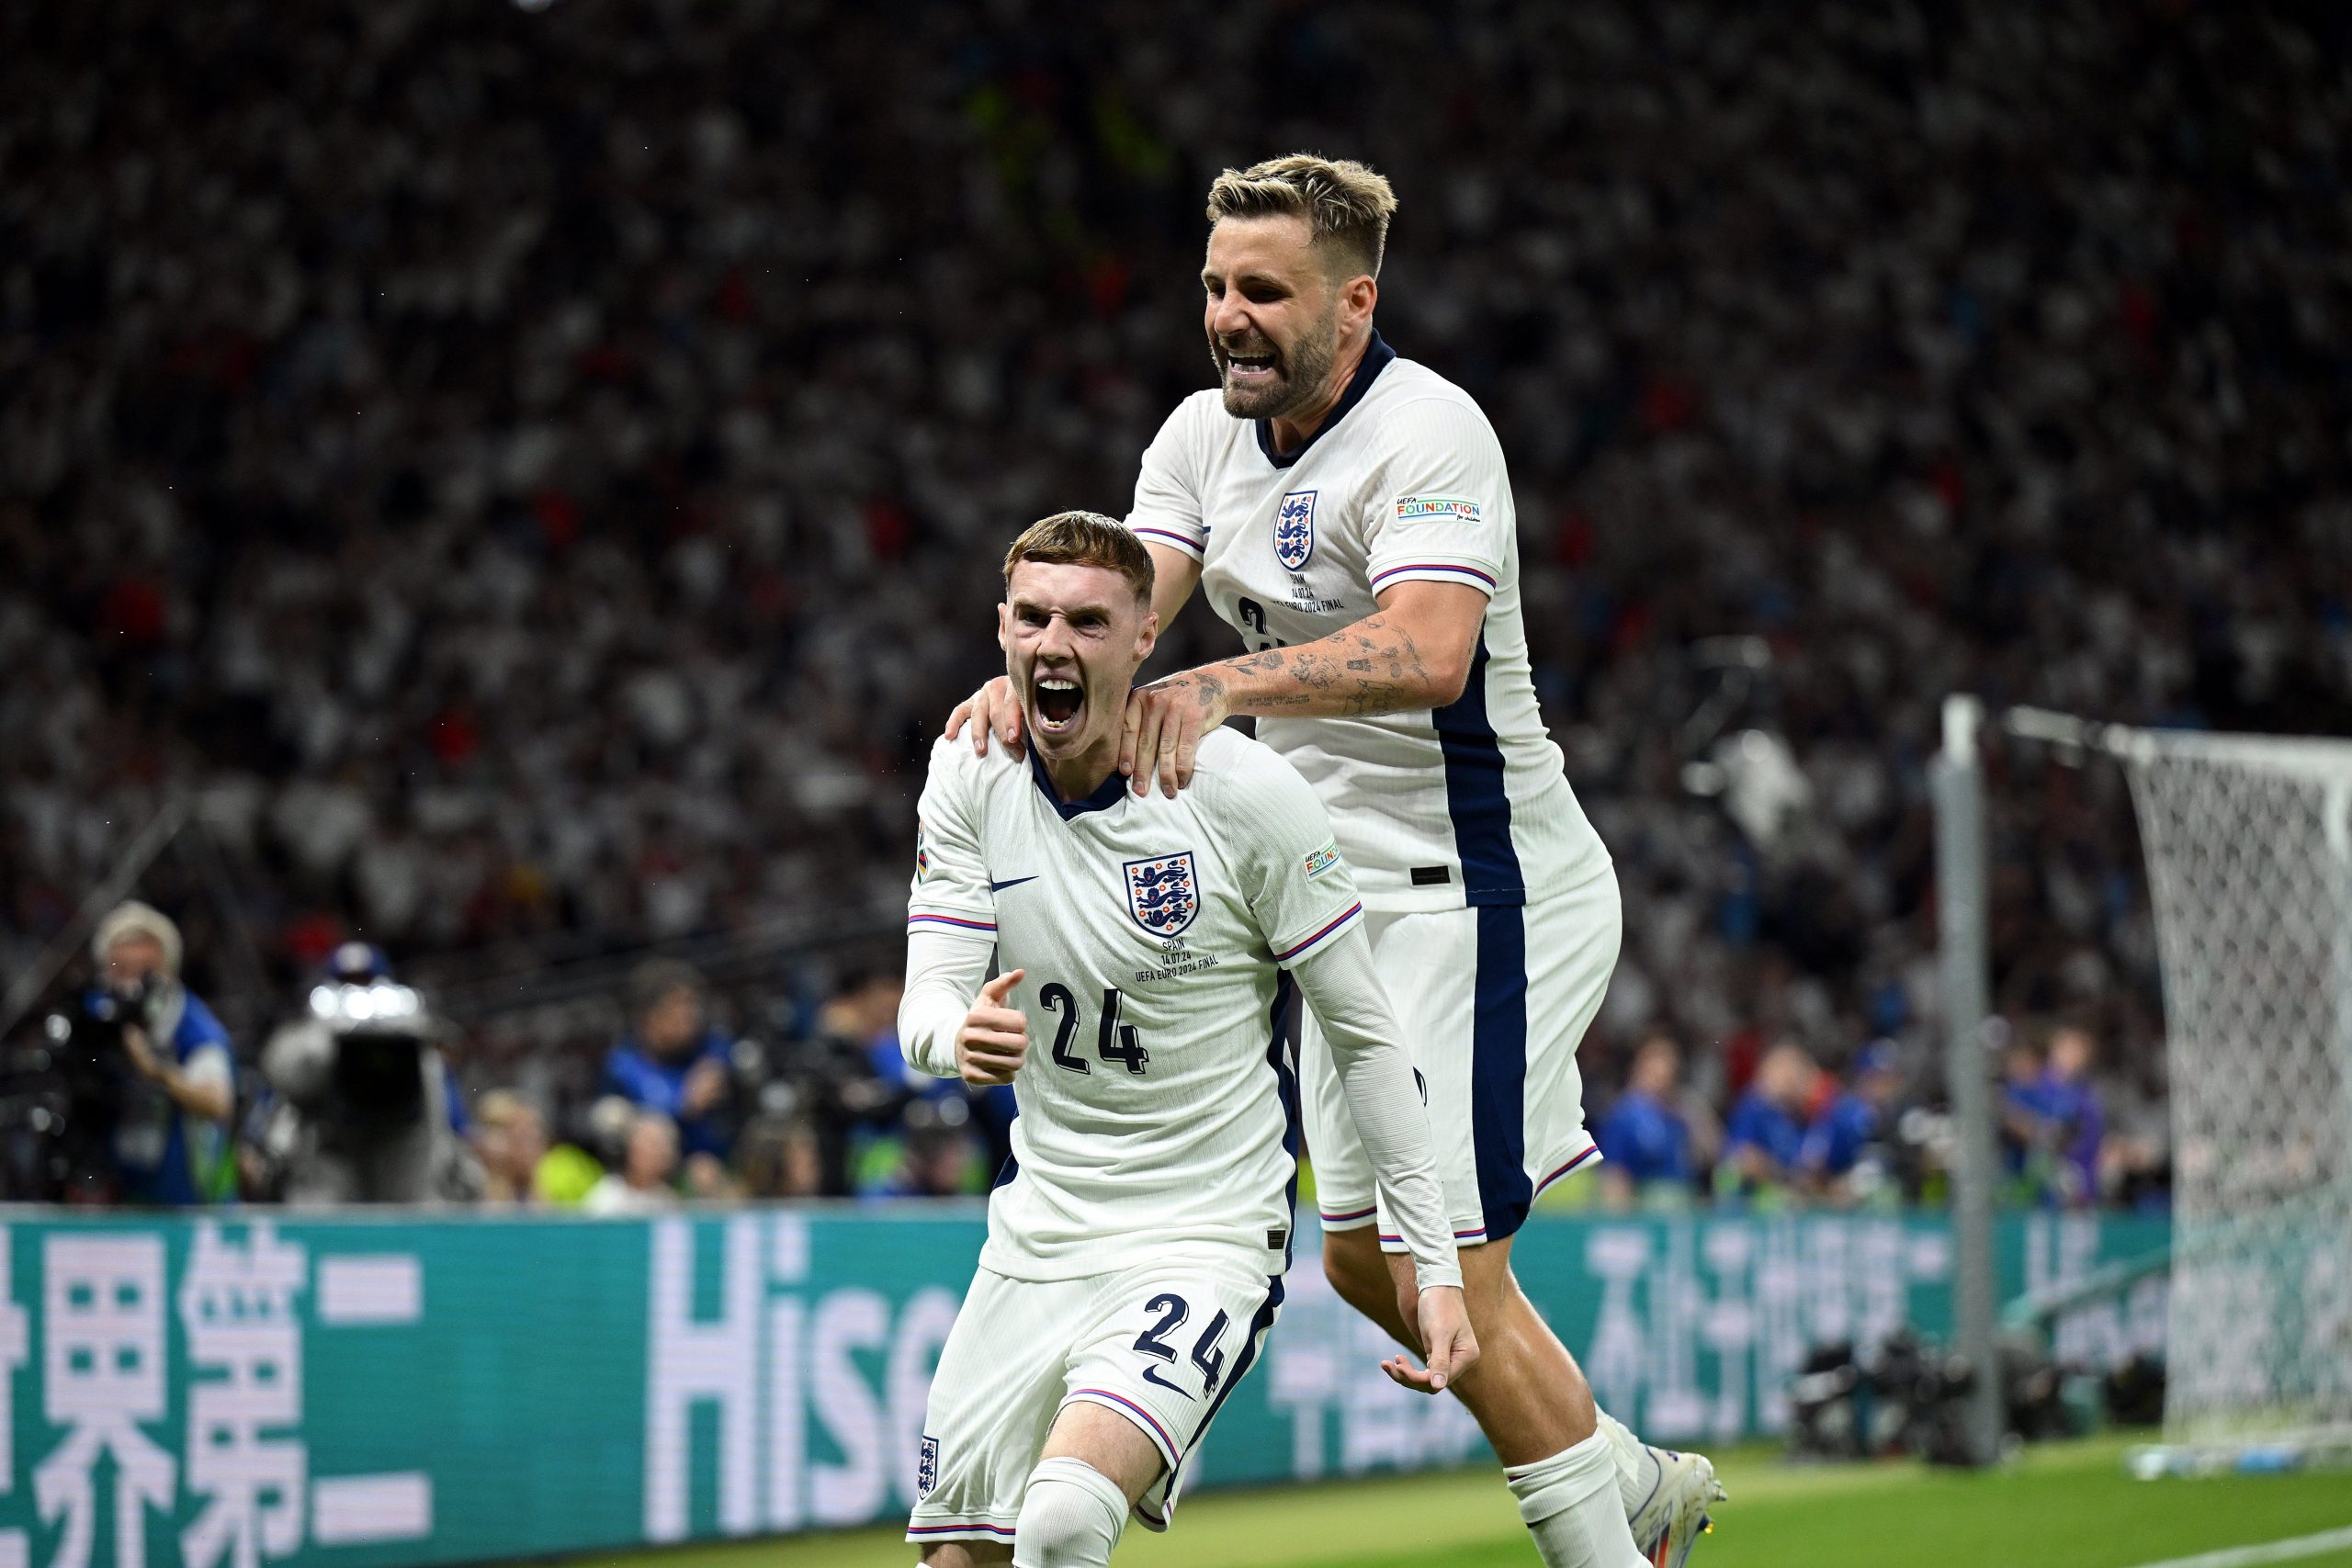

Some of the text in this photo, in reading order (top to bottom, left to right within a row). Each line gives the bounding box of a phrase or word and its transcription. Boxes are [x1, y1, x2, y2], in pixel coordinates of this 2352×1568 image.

[1305, 601, 1321, 613] 2024
[1320, 598, 1344, 612] FINAL
[1305, 851, 1321, 863] UEFA
[1162, 937, 1186, 952] SPAIN
[1136, 953, 1219, 982] UEFA EURO 2024 FINAL
[1160, 951, 1192, 966] 14.07.24
[1039, 982, 1149, 1075] 24
[1133, 1293, 1230, 1400] 24
[0, 1218, 432, 1568] 界第二
